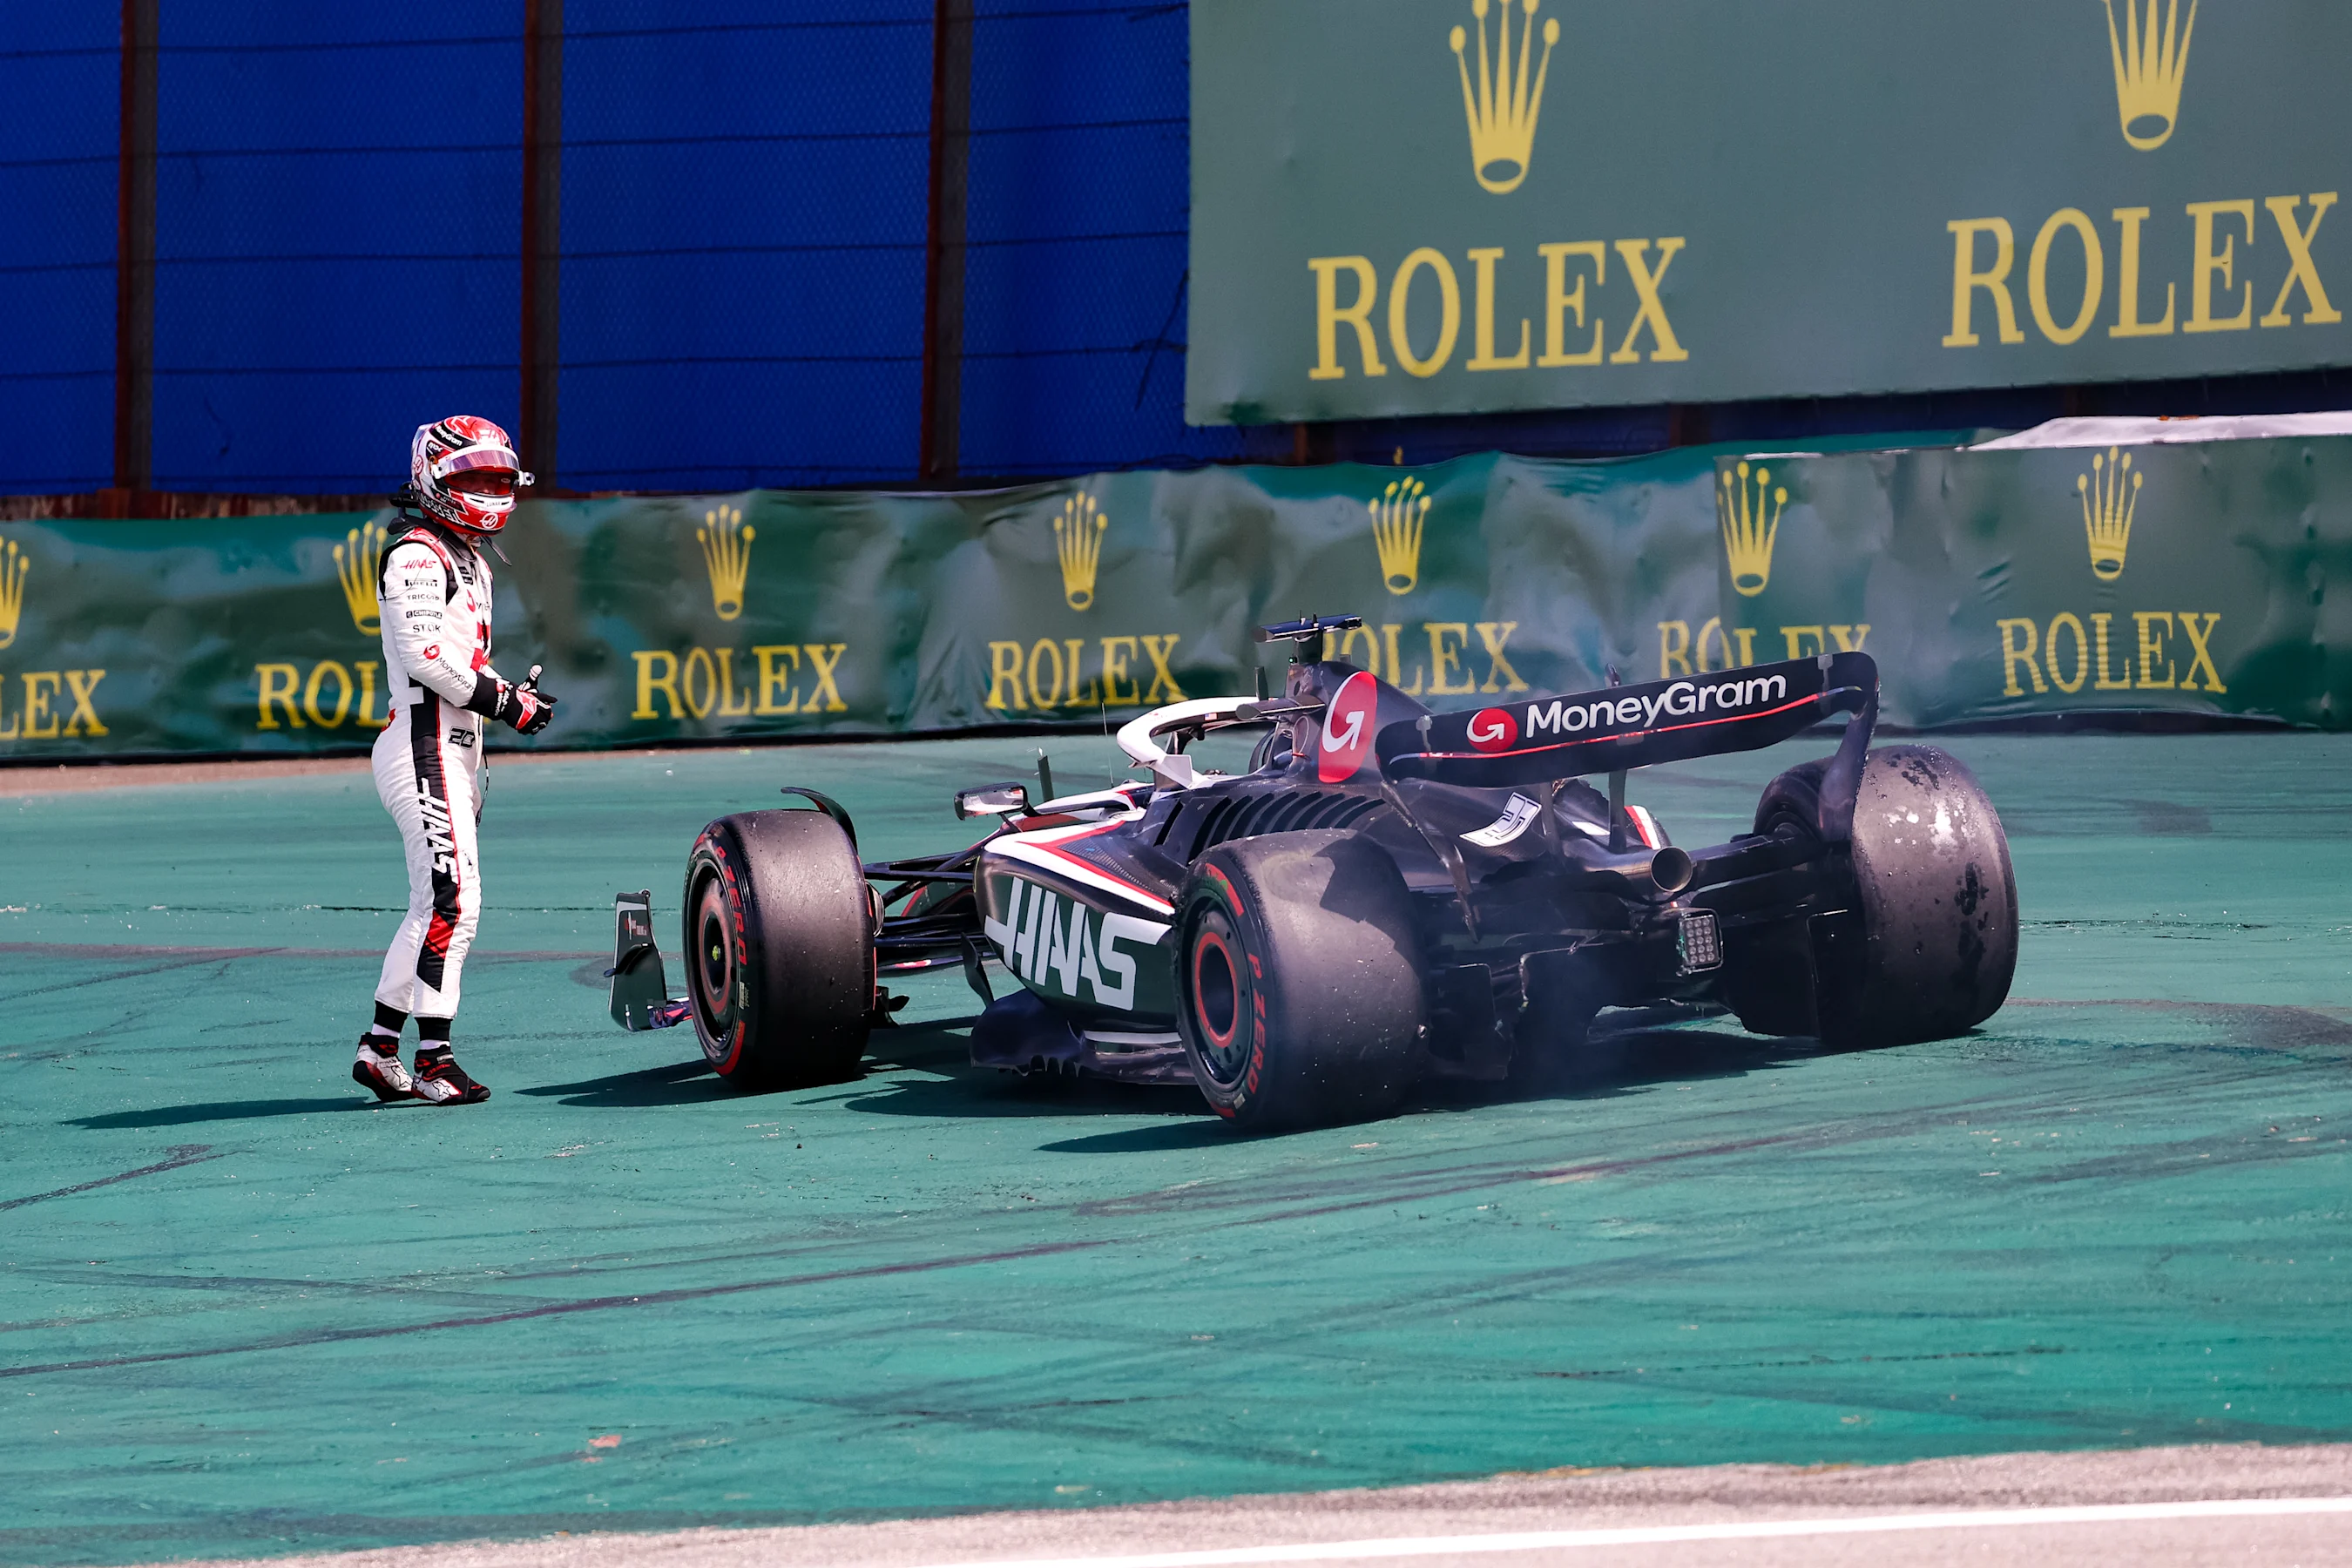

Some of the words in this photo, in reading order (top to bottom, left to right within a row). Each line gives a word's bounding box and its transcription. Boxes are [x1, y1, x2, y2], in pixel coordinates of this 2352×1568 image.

[1308, 236, 1689, 380] ROLEX
[1943, 192, 2342, 348] ROLEX
[400, 559, 437, 570] HAAS
[630, 642, 849, 720] ROLEX
[986, 633, 1189, 711] ROLEX
[1996, 611, 2227, 697] ROLEX
[448, 726, 476, 748] 20
[1525, 673, 1788, 740] MoneyGram
[715, 845, 727, 859] P
[723, 865, 747, 966] ZERO
[984, 875, 1173, 1011] HAAS
[1248, 953, 1262, 980] P
[1246, 989, 1266, 1094] ZERO
